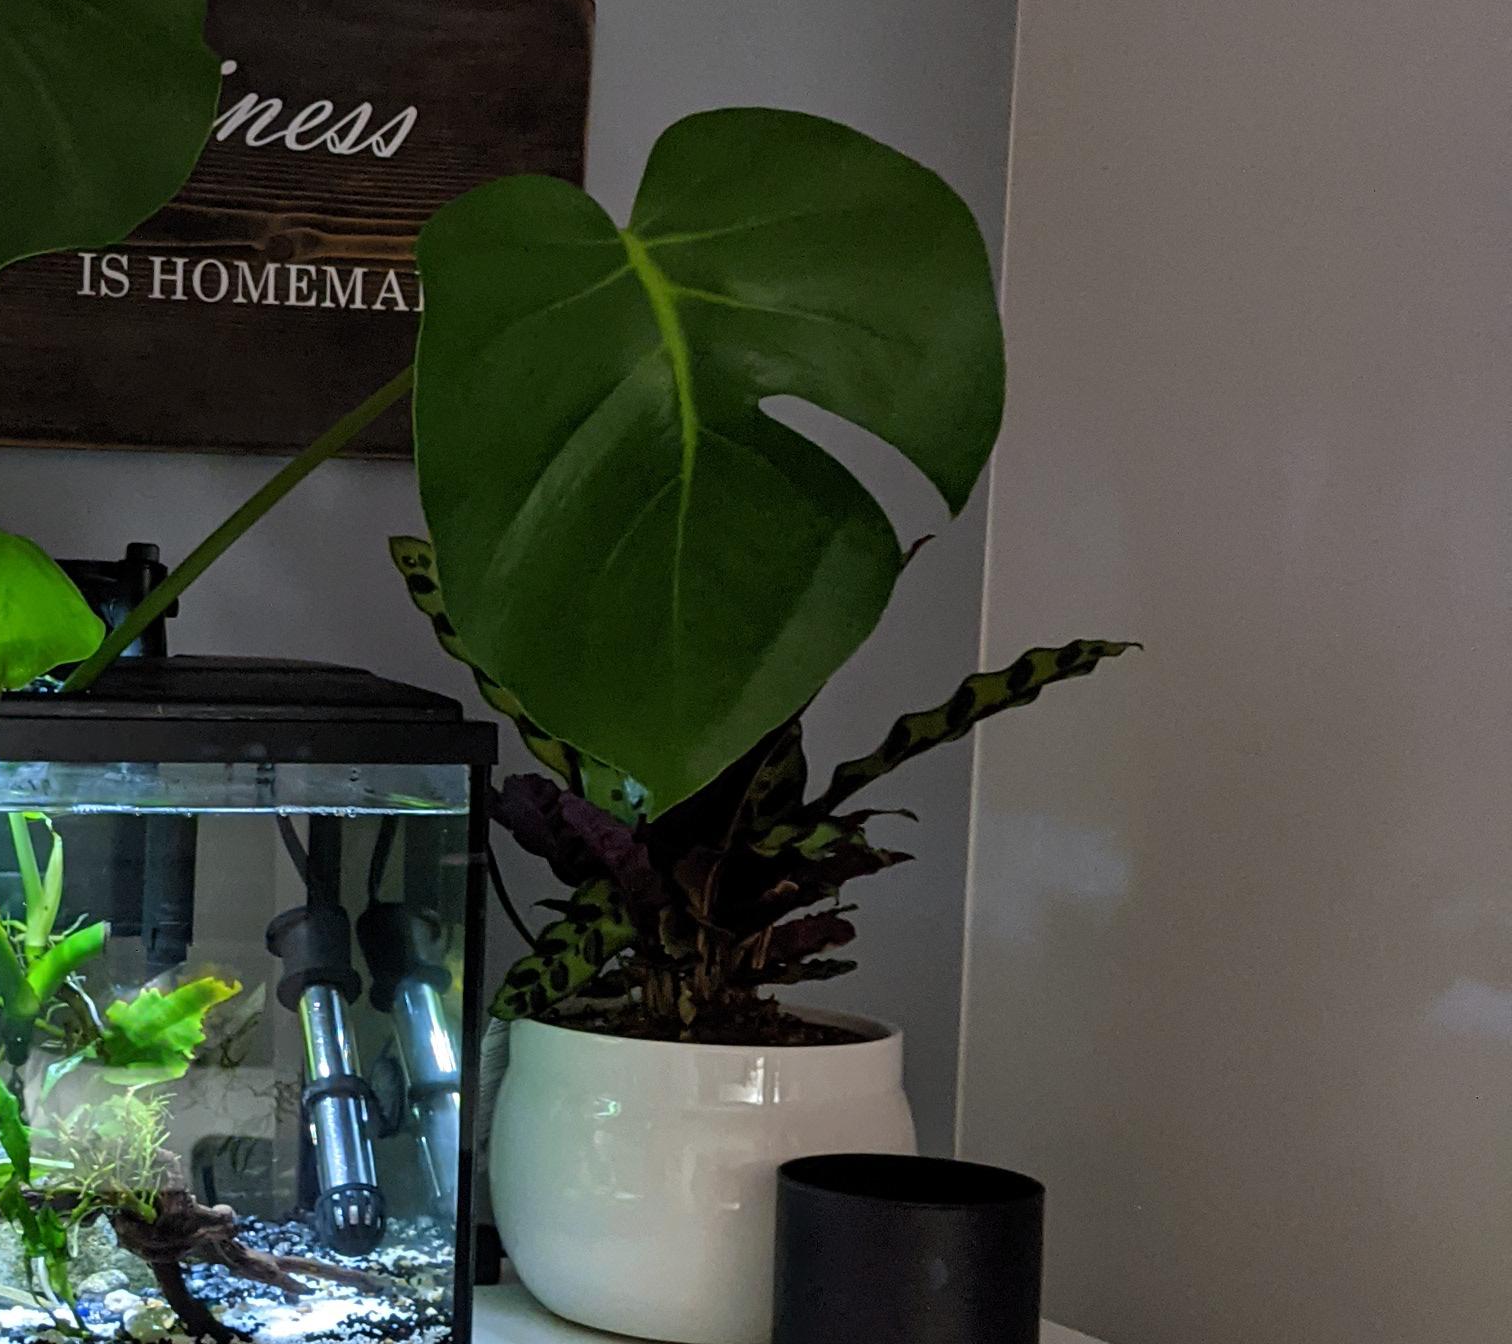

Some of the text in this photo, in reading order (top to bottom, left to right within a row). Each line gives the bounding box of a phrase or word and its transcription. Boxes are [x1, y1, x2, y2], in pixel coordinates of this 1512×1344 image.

[213, 59, 419, 158] ness
[76, 252, 425, 312] IS HOMEMA
